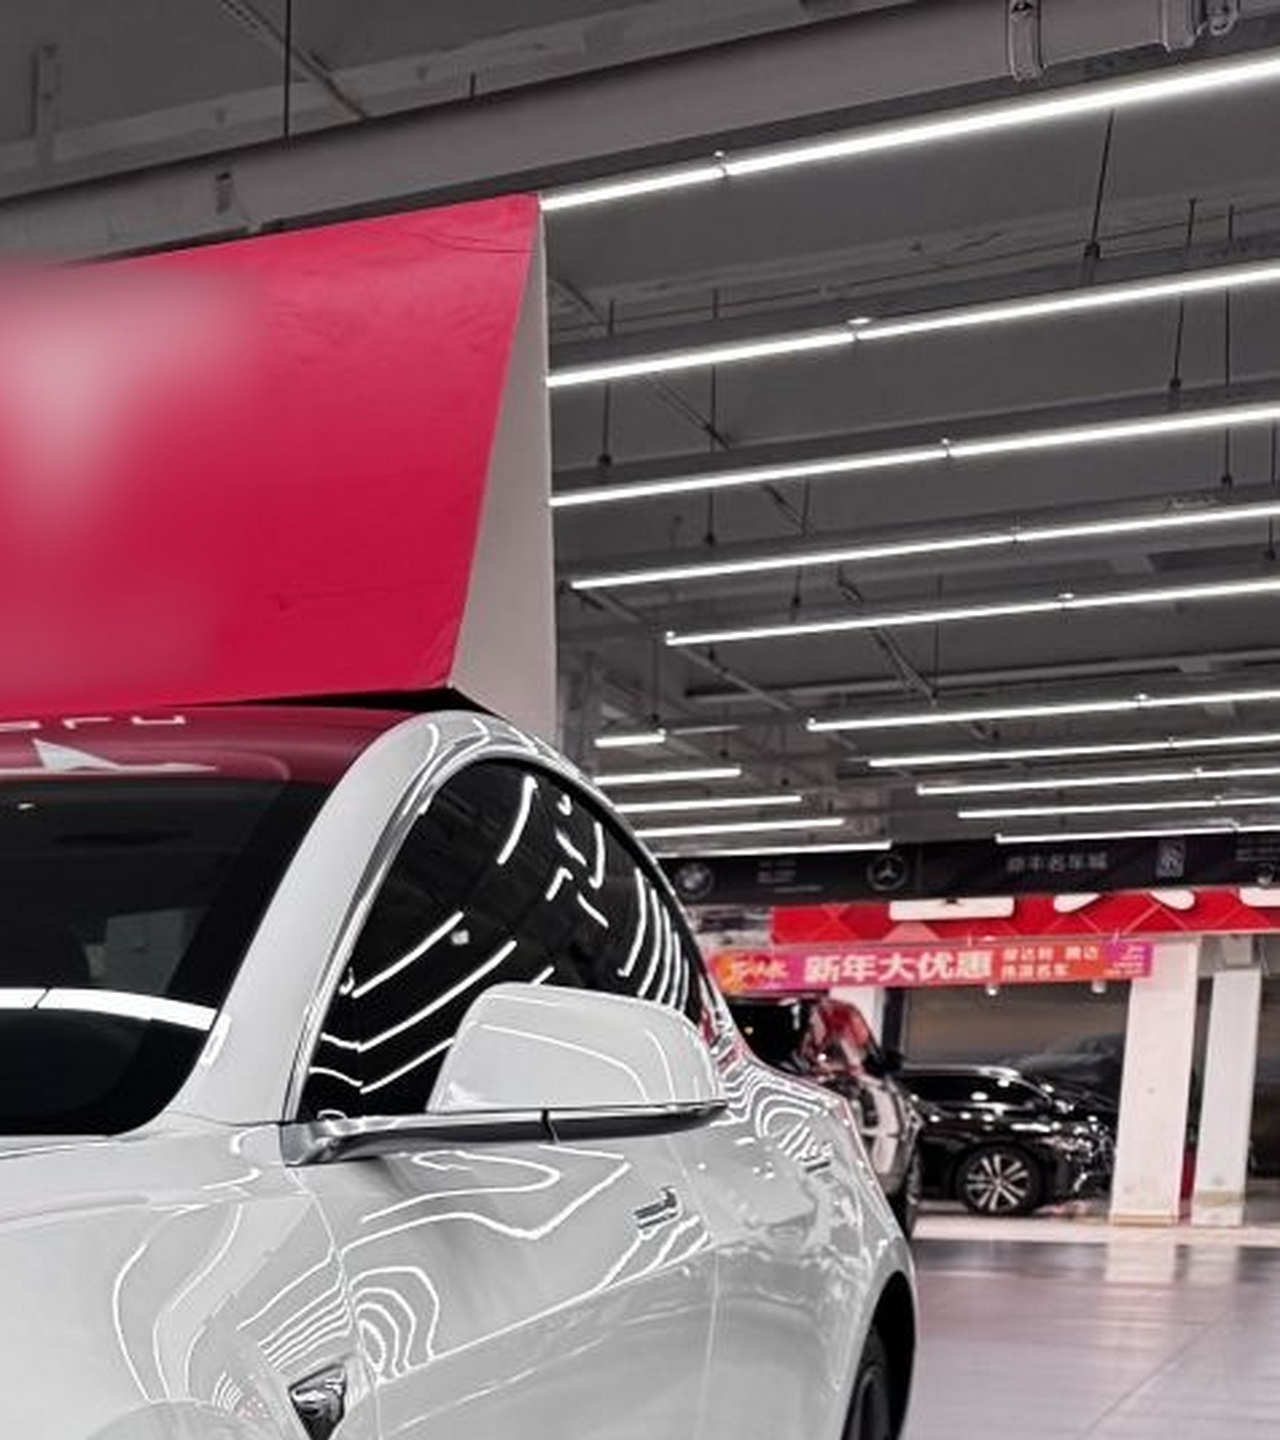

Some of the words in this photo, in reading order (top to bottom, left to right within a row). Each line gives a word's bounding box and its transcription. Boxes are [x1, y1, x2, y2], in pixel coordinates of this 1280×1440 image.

[803, 950, 992, 982] 新年大优惠
